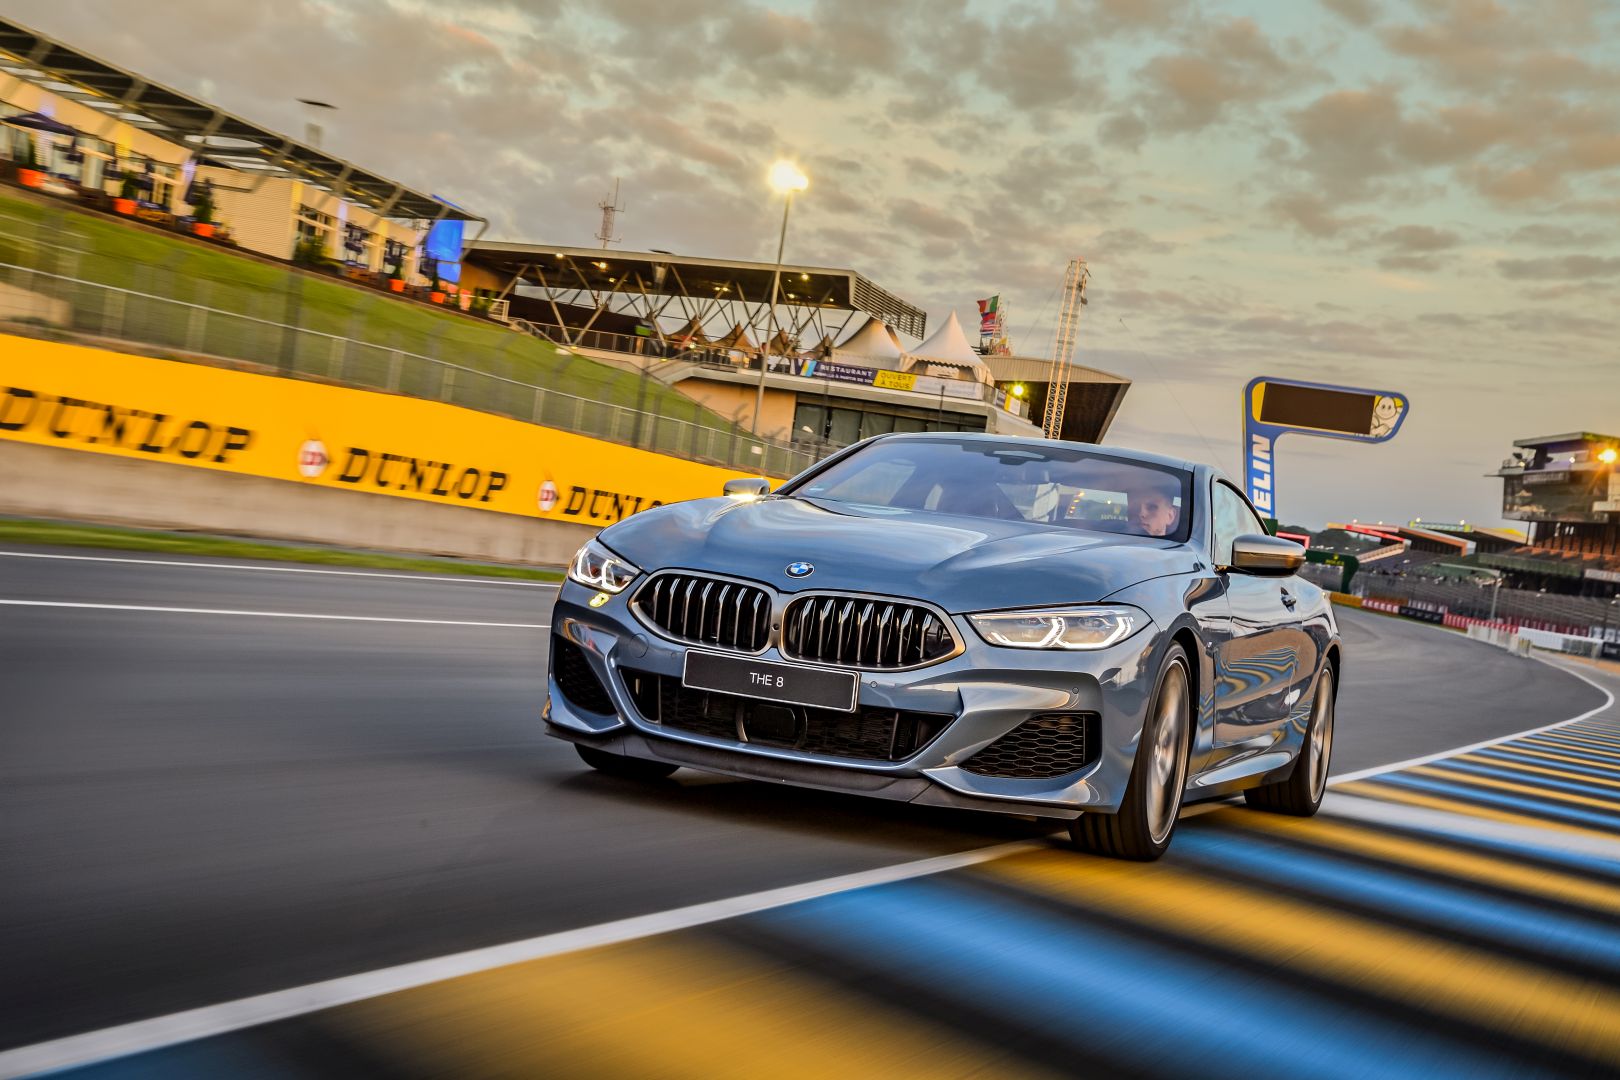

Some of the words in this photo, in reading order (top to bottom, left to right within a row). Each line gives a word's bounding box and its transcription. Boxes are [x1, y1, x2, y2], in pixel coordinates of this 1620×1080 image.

[820, 364, 873, 377] RESTAURANT
[881, 372, 913, 381] OUVERT
[888, 380, 911, 389] TOUS
[0, 387, 252, 462] DUNLOP
[338, 447, 508, 502] DUNLOP
[564, 486, 662, 520] DUNL
[750, 672, 773, 686] THE
[776, 676, 784, 688] 8
